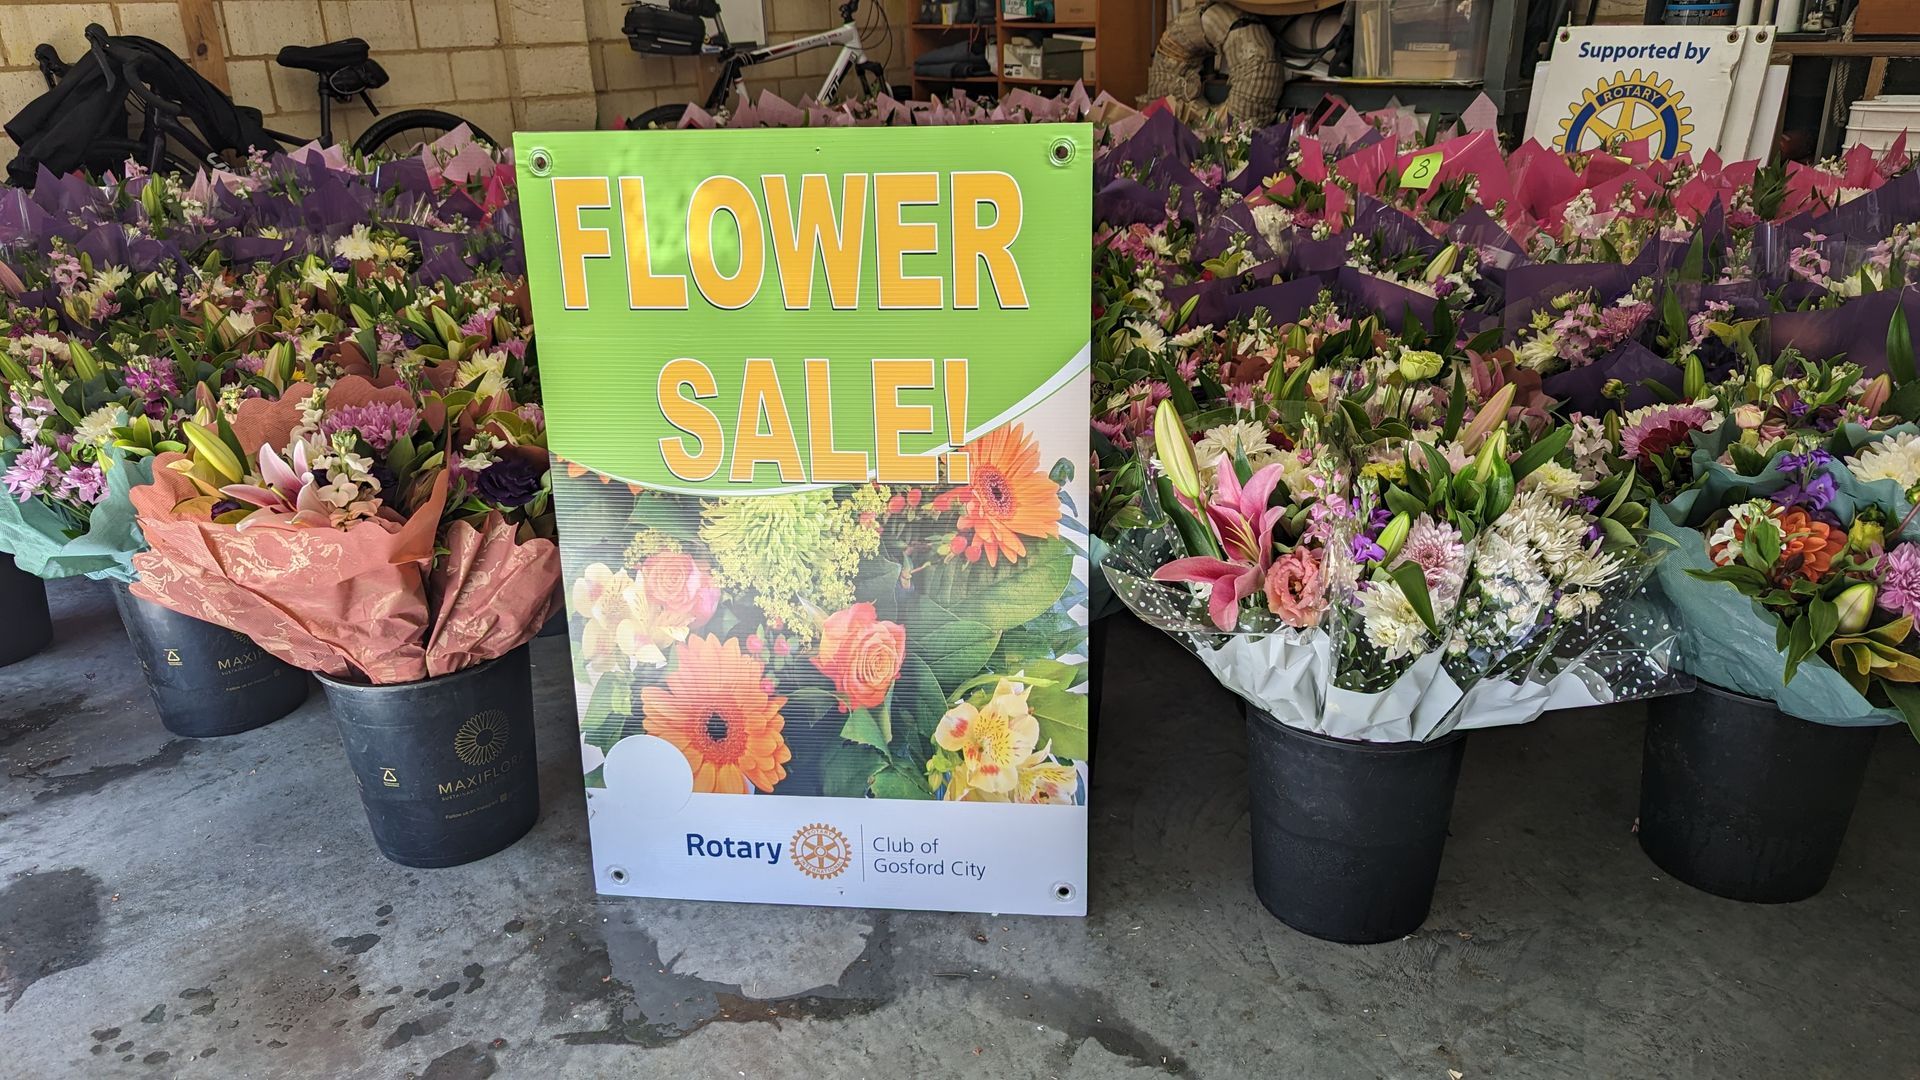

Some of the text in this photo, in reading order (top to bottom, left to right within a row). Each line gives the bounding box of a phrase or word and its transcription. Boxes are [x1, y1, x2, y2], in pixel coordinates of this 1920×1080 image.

[1578, 42, 1711, 63] Supported by
[1603, 85, 1662, 103] ROTARY
[1413, 159, 1430, 178] 8
[551, 171, 1030, 310] FLOWER
[656, 358, 970, 484] SALE!
[217, 649, 265, 670] MAXIF
[686, 833, 782, 865] Rotary
[873, 836, 940, 854] Club of
[874, 858, 986, 881] Gosford City
